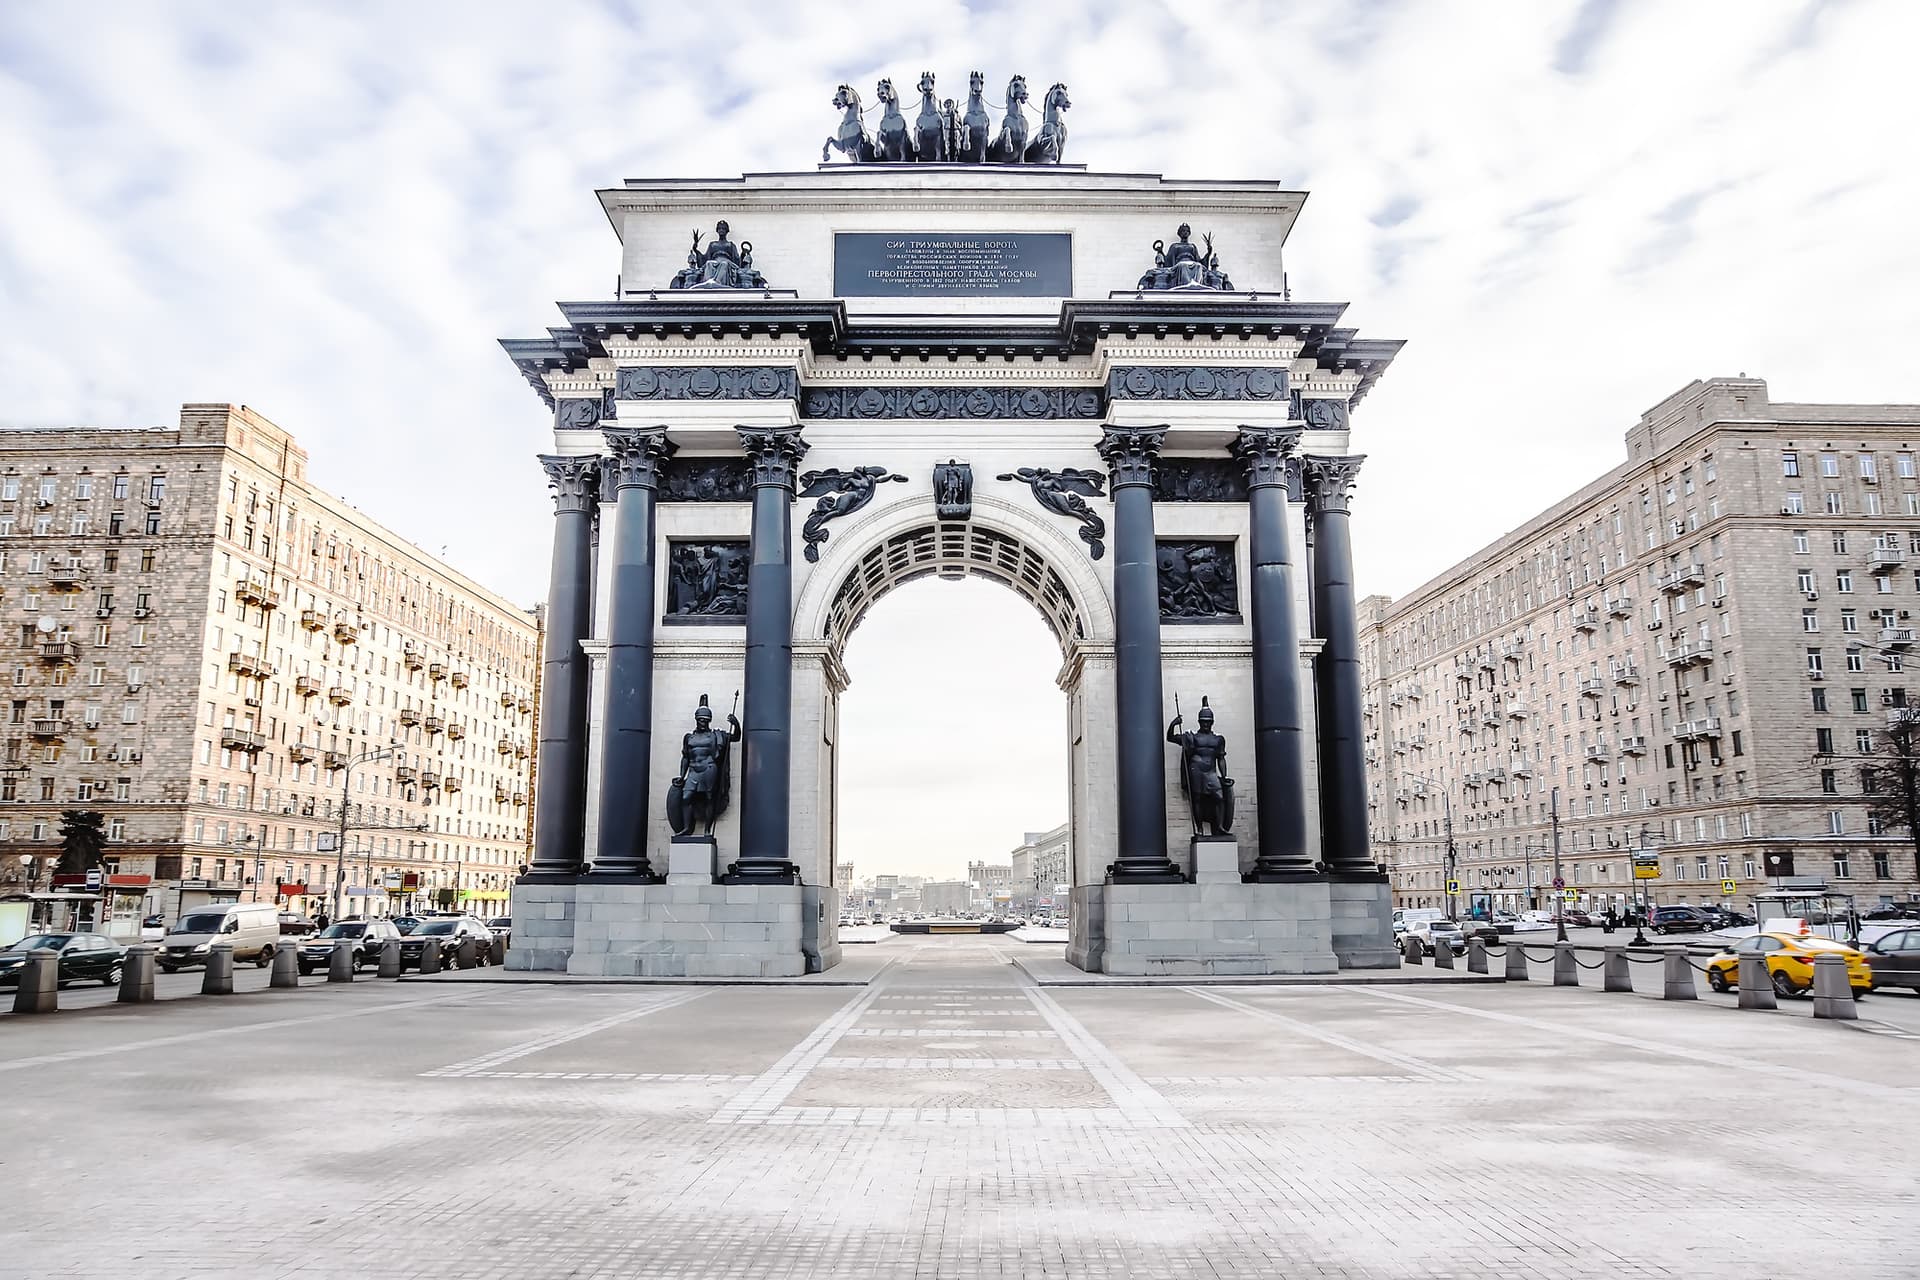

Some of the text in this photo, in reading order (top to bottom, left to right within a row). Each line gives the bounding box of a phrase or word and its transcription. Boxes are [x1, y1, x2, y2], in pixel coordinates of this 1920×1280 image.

[886, 241, 1018, 249] СИИ ТРИУМФАЛЬНЫЕ ВОРОТА
[868, 270, 1037, 278] ПЕРВОПРЕСТОЛЬНОГО ГРАДА МОСКВЫ
